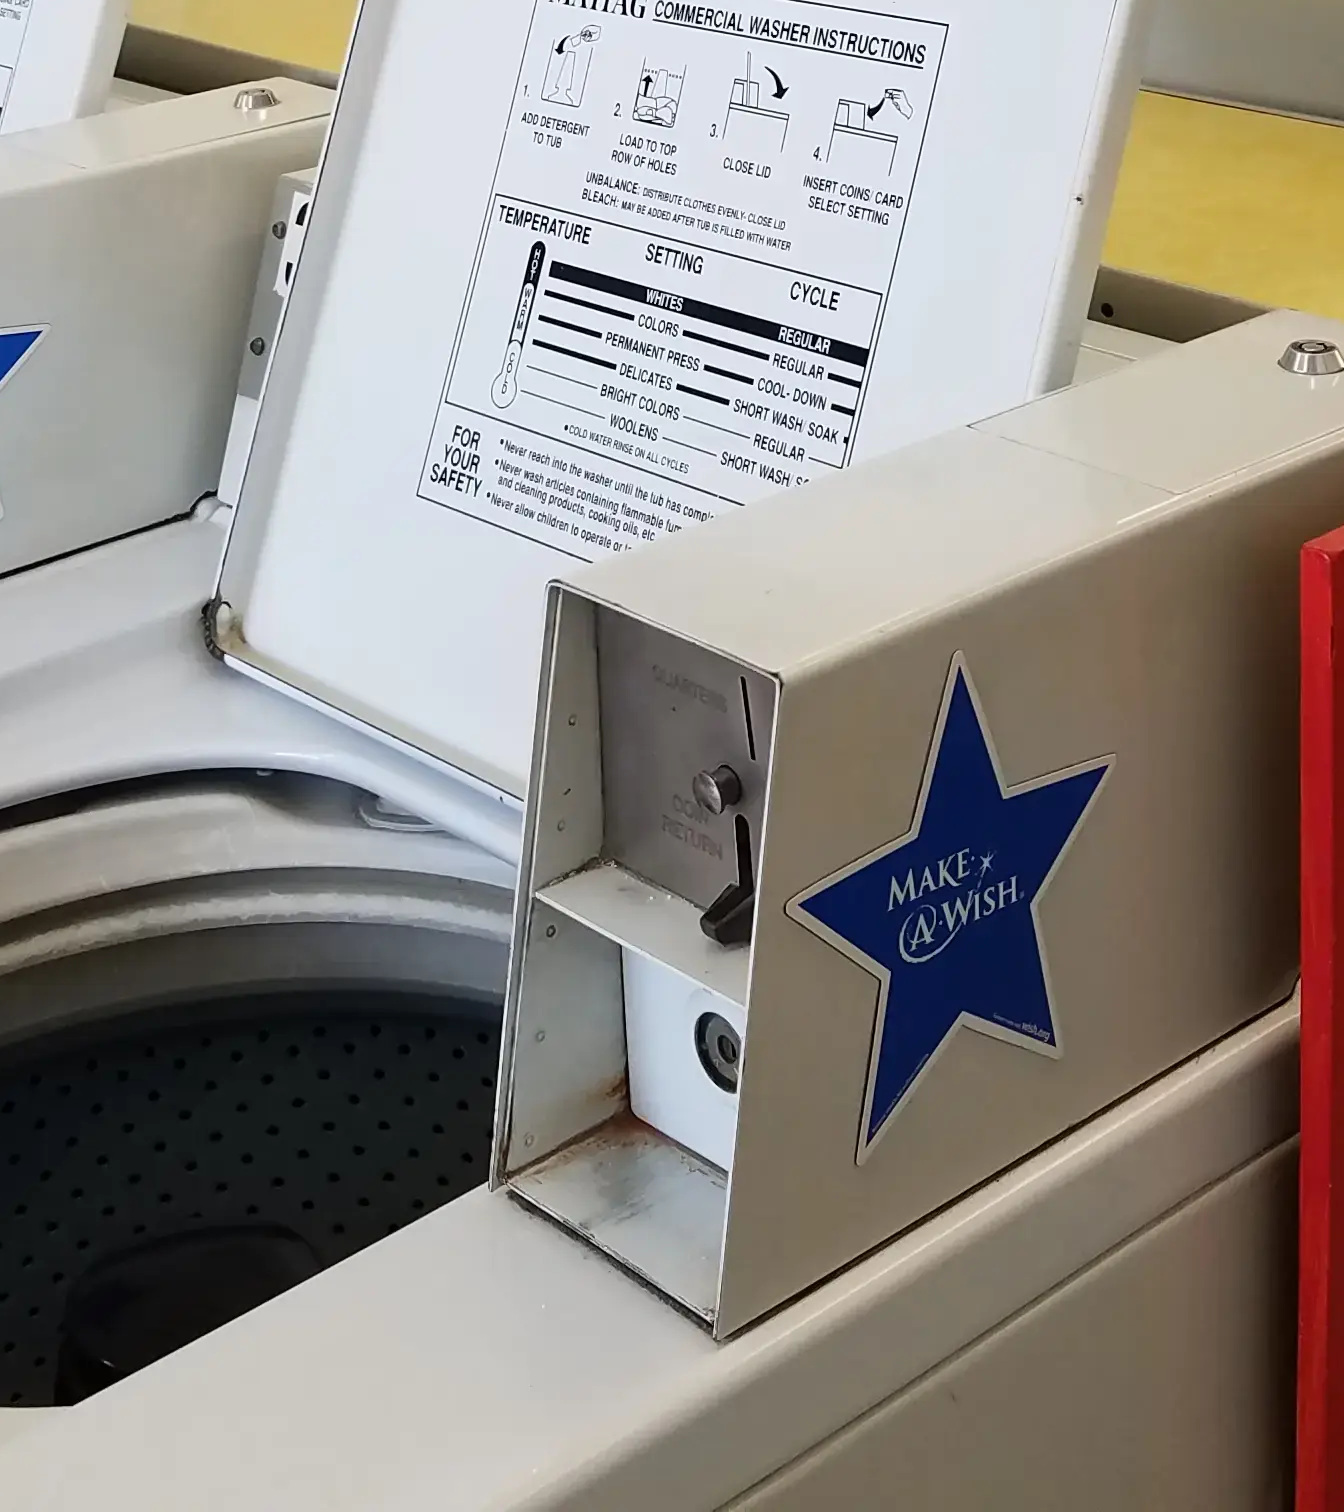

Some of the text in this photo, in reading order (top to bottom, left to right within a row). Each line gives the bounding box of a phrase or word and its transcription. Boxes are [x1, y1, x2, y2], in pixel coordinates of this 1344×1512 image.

[654, 0, 744, 32] COMMERCIAL
[749, 16, 810, 43] WASHER
[813, 27, 927, 65] INSTRUCTIONS
[521, 112, 590, 137] ADD DETERGENT
[533, 132, 562, 148] TO TUB
[619, 134, 677, 156] LOAD TO TOP
[611, 150, 677, 176] ROW OF HOLES
[723, 157, 771, 178] CLOSE LID
[586, 171, 640, 195] UNBALANCE:
[643, 187, 683, 205] DISTRIBUTE
[684, 197, 716, 214] CLOTHES
[748, 213, 773, 228] CLOSE
[774, 219, 786, 230] LID
[803, 175, 838, 194] INSERT
[875, 192, 904, 209] CARD
[808, 196, 889, 225] SELECT SETTING
[498, 205, 704, 275] TEMPERATURE SETTING
[582, 188, 791, 251] BLEACH: MAY BE ADDED AFTER TUB IS FILLED WITH WATER
[529, 249, 541, 280] HOT
[646, 288, 831, 354] WHITES REGULAR
[790, 282, 840, 311] CYCLE
[605, 332, 665, 359] PERMANENT
[667, 350, 701, 371] PRESS
[638, 314, 824, 380] COLORS REGULAR
[601, 384, 805, 462] BRIGHT COLORS REGULAR
[619, 363, 673, 391] DELICATES
[733, 399, 770, 422] SHORT
[808, 422, 839, 444] SOAK
[444, 444, 480, 474] YOUR
[452, 425, 481, 451] FOR
[569, 425, 689, 474] COLD WATER RINSE ON ALL CYCLES
[610, 413, 659, 441] WOOLENS
[720, 451, 757, 474] SHORT
[430, 463, 482, 497] SAFETY
[499, 459, 664, 530] Never wash articles containing flammable
[504, 440, 527, 457] Never
[528, 450, 551, 465] reach
[552, 456, 568, 472] into
[569, 463, 582, 477] the
[584, 470, 613, 488] washer
[615, 481, 634, 496] until
[635, 487, 648, 500] the
[650, 492, 664, 507] tub
[665, 498, 681, 513] has
[491, 493, 622, 552] Never allow children to operate or
[498, 475, 513, 489] and
[515, 480, 547, 504] cleaning
[588, 508, 621, 531] cooking
